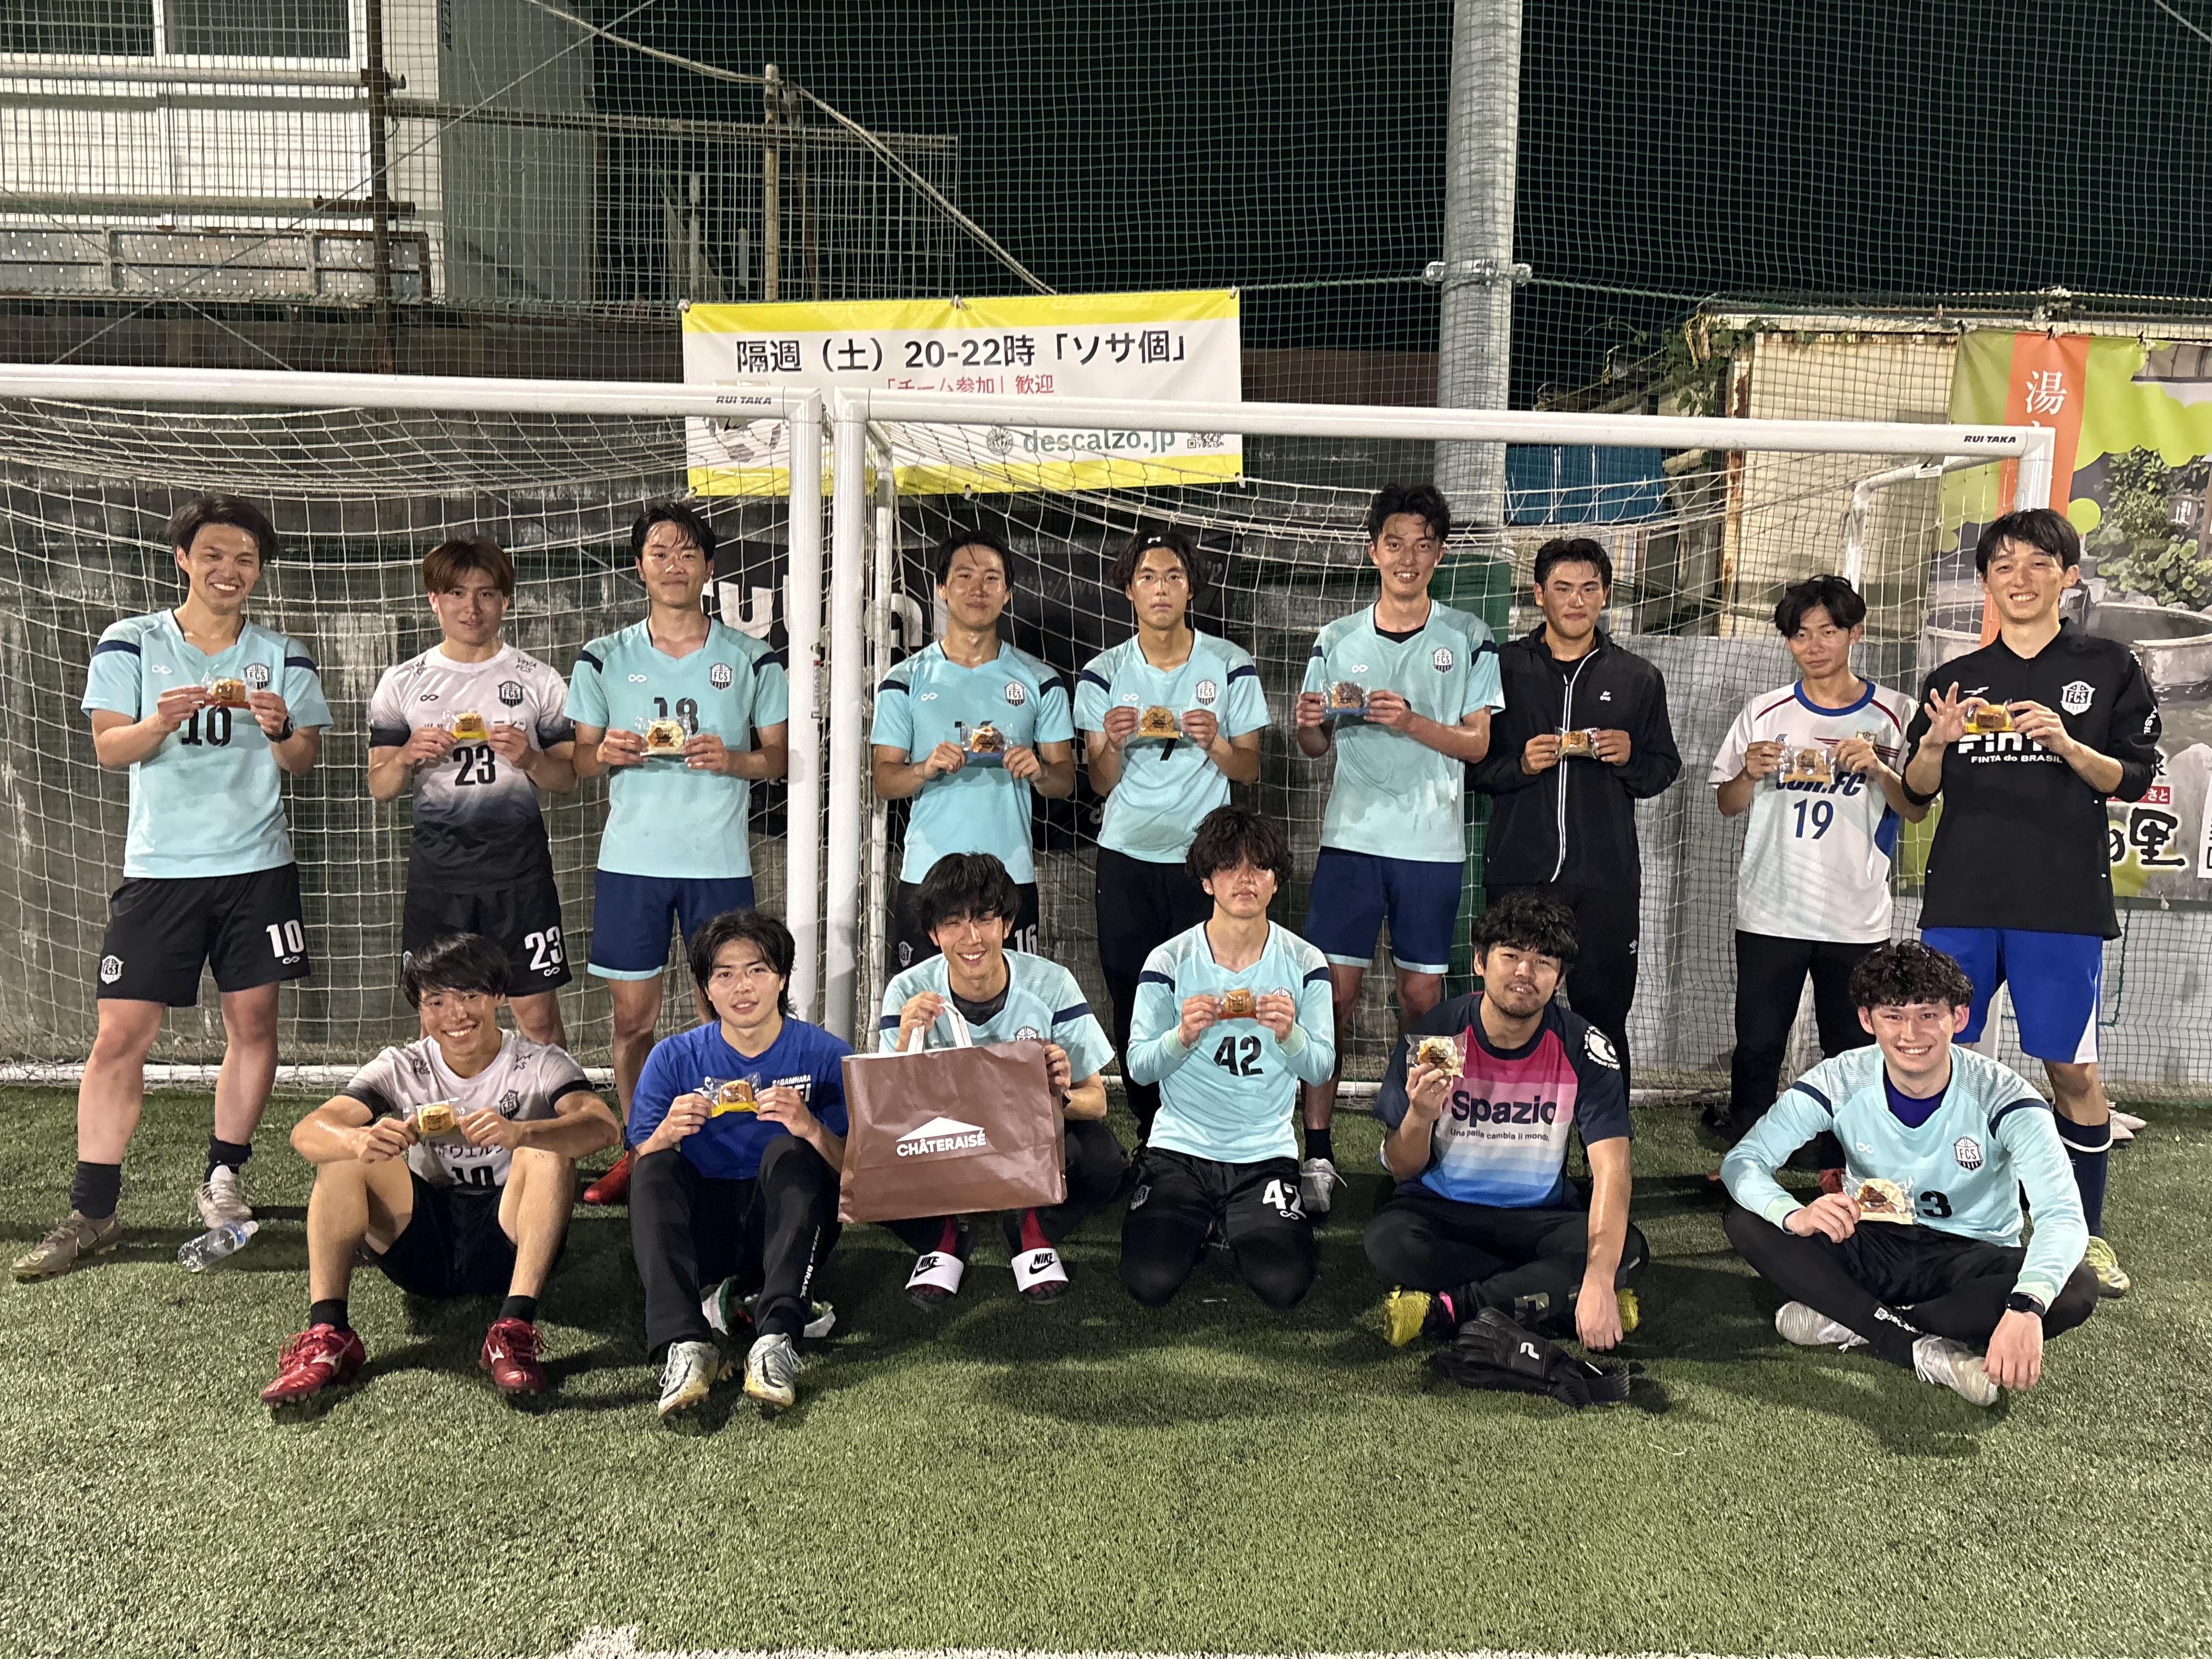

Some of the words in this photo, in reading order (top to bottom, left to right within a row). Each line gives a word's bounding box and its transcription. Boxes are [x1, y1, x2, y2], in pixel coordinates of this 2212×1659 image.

[2024, 370, 2067, 426] 湯
[1023, 430, 1176, 453] descalzo.jp
[1436, 656, 1450, 664] FCS
[250, 671, 266, 681] FCS
[714, 671, 728, 681] FCS
[503, 689, 518, 699] FCS
[1008, 690, 1021, 699] FCS
[1200, 687, 1212, 697] FCS
[2068, 691, 2086, 704] FCS
[181, 706, 232, 747] 10
[453, 744, 496, 787] 23
[1971, 755, 2002, 763] FINTA
[2021, 754, 2063, 764] BRASIL
[1793, 798, 1834, 840] 19
[266, 919, 304, 958] 10
[524, 926, 564, 971] 23
[104, 964, 117, 975] FCS
[1213, 1036, 1264, 1076] 42
[1452, 1090, 1557, 1127] Spazio
[896, 1130, 986, 1157] CHÂTERAISÉ
[1960, 1147, 1977, 1160] FCS
[1917, 1190, 1953, 1218] 3
[918, 1256, 940, 1269] NIKE
[1034, 1252, 1053, 1266] NIKE
